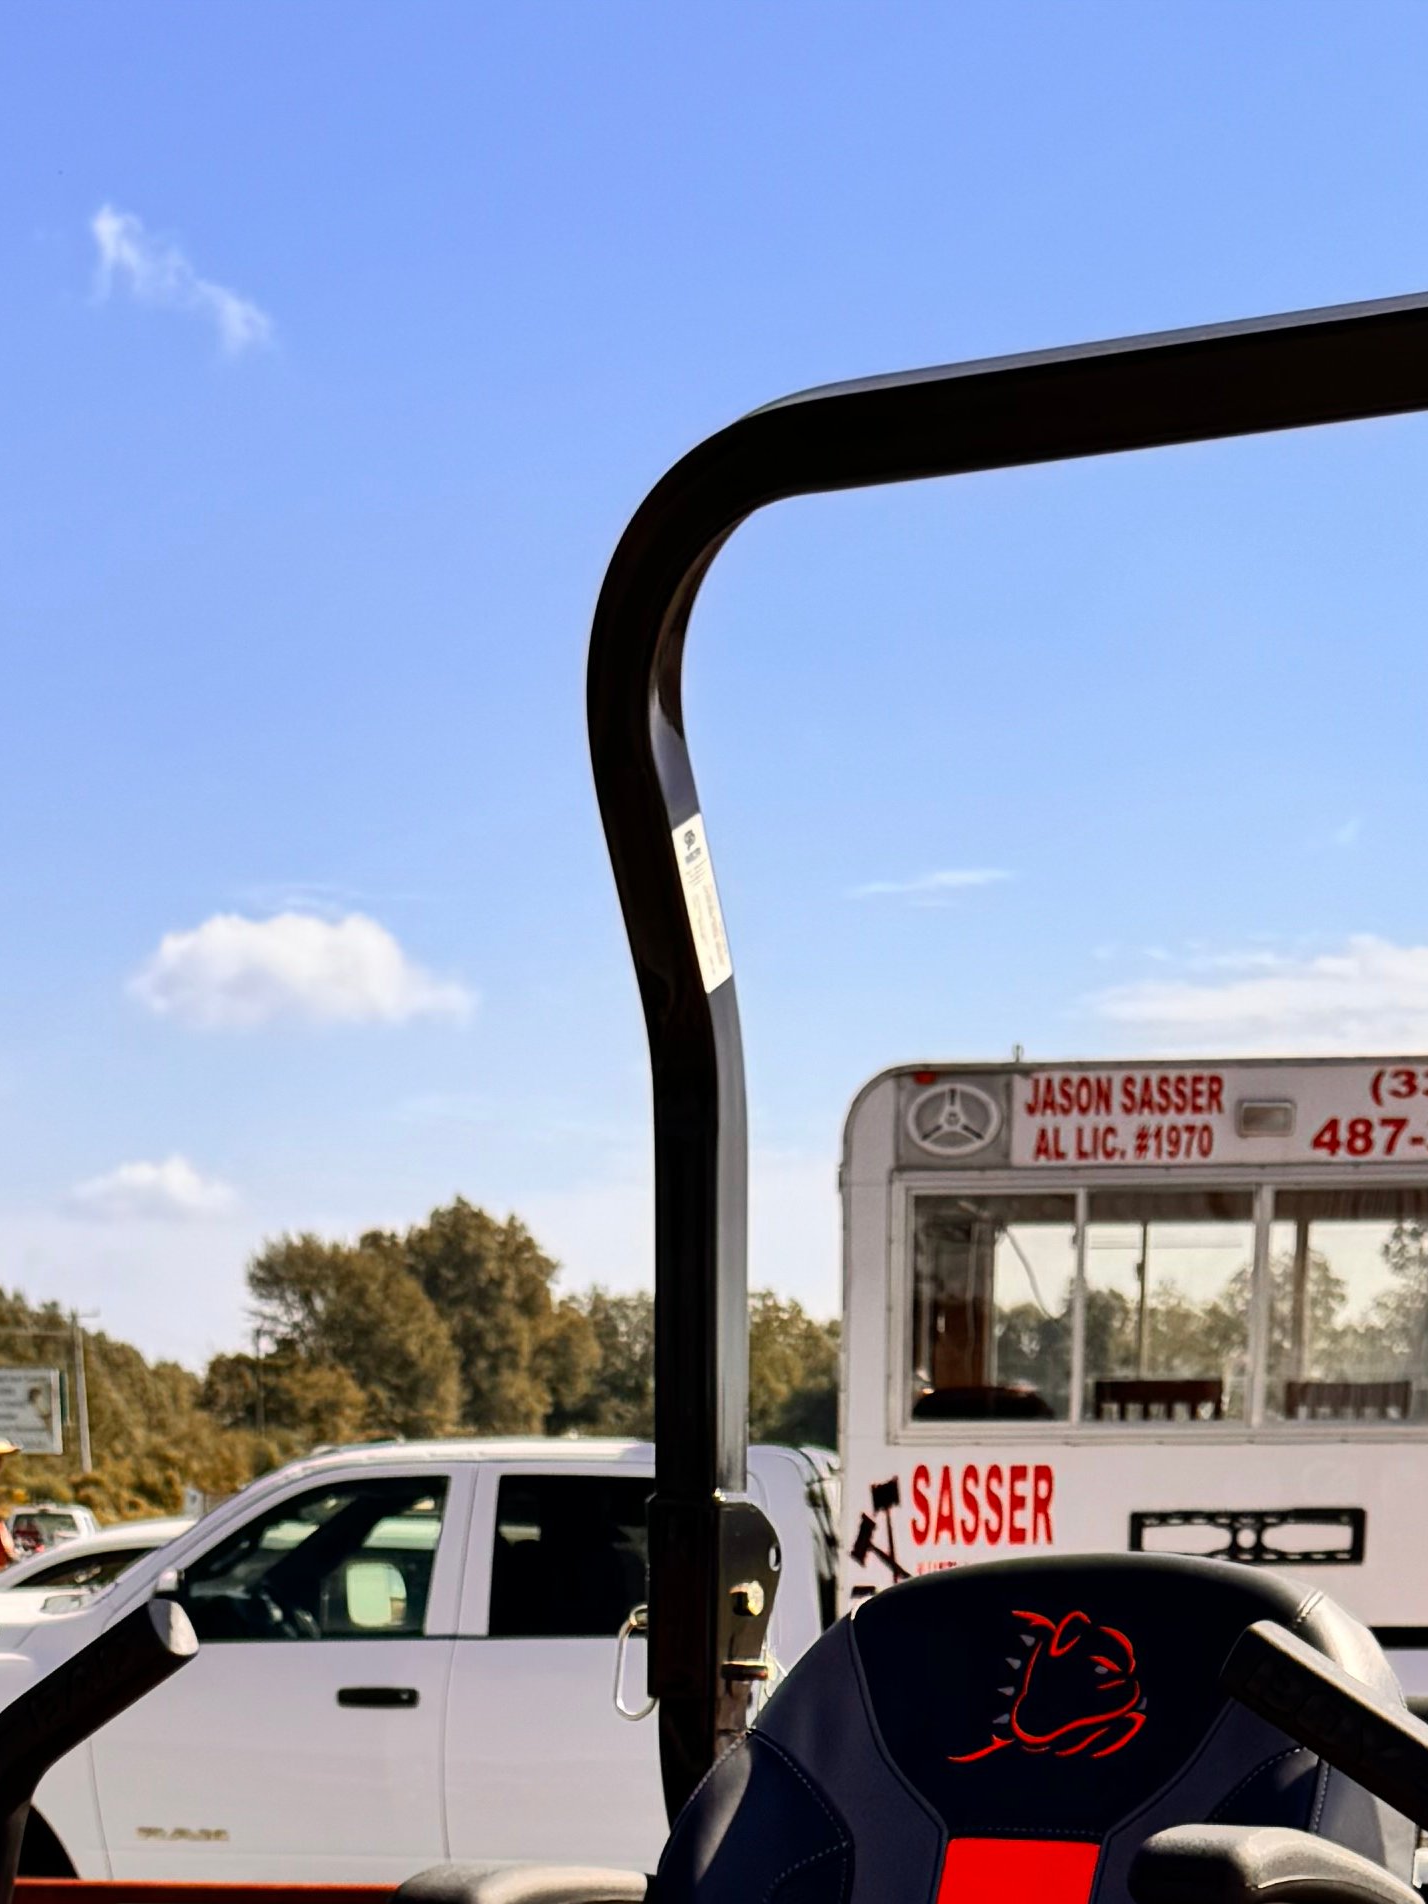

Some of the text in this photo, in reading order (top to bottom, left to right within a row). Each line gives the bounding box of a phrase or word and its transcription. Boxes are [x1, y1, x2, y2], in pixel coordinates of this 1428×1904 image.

[1026, 1075, 1224, 1116] JASON SASSER
[1034, 1124, 1213, 1161] AL LIC. #1970
[911, 1464, 1054, 1546] SASSER
